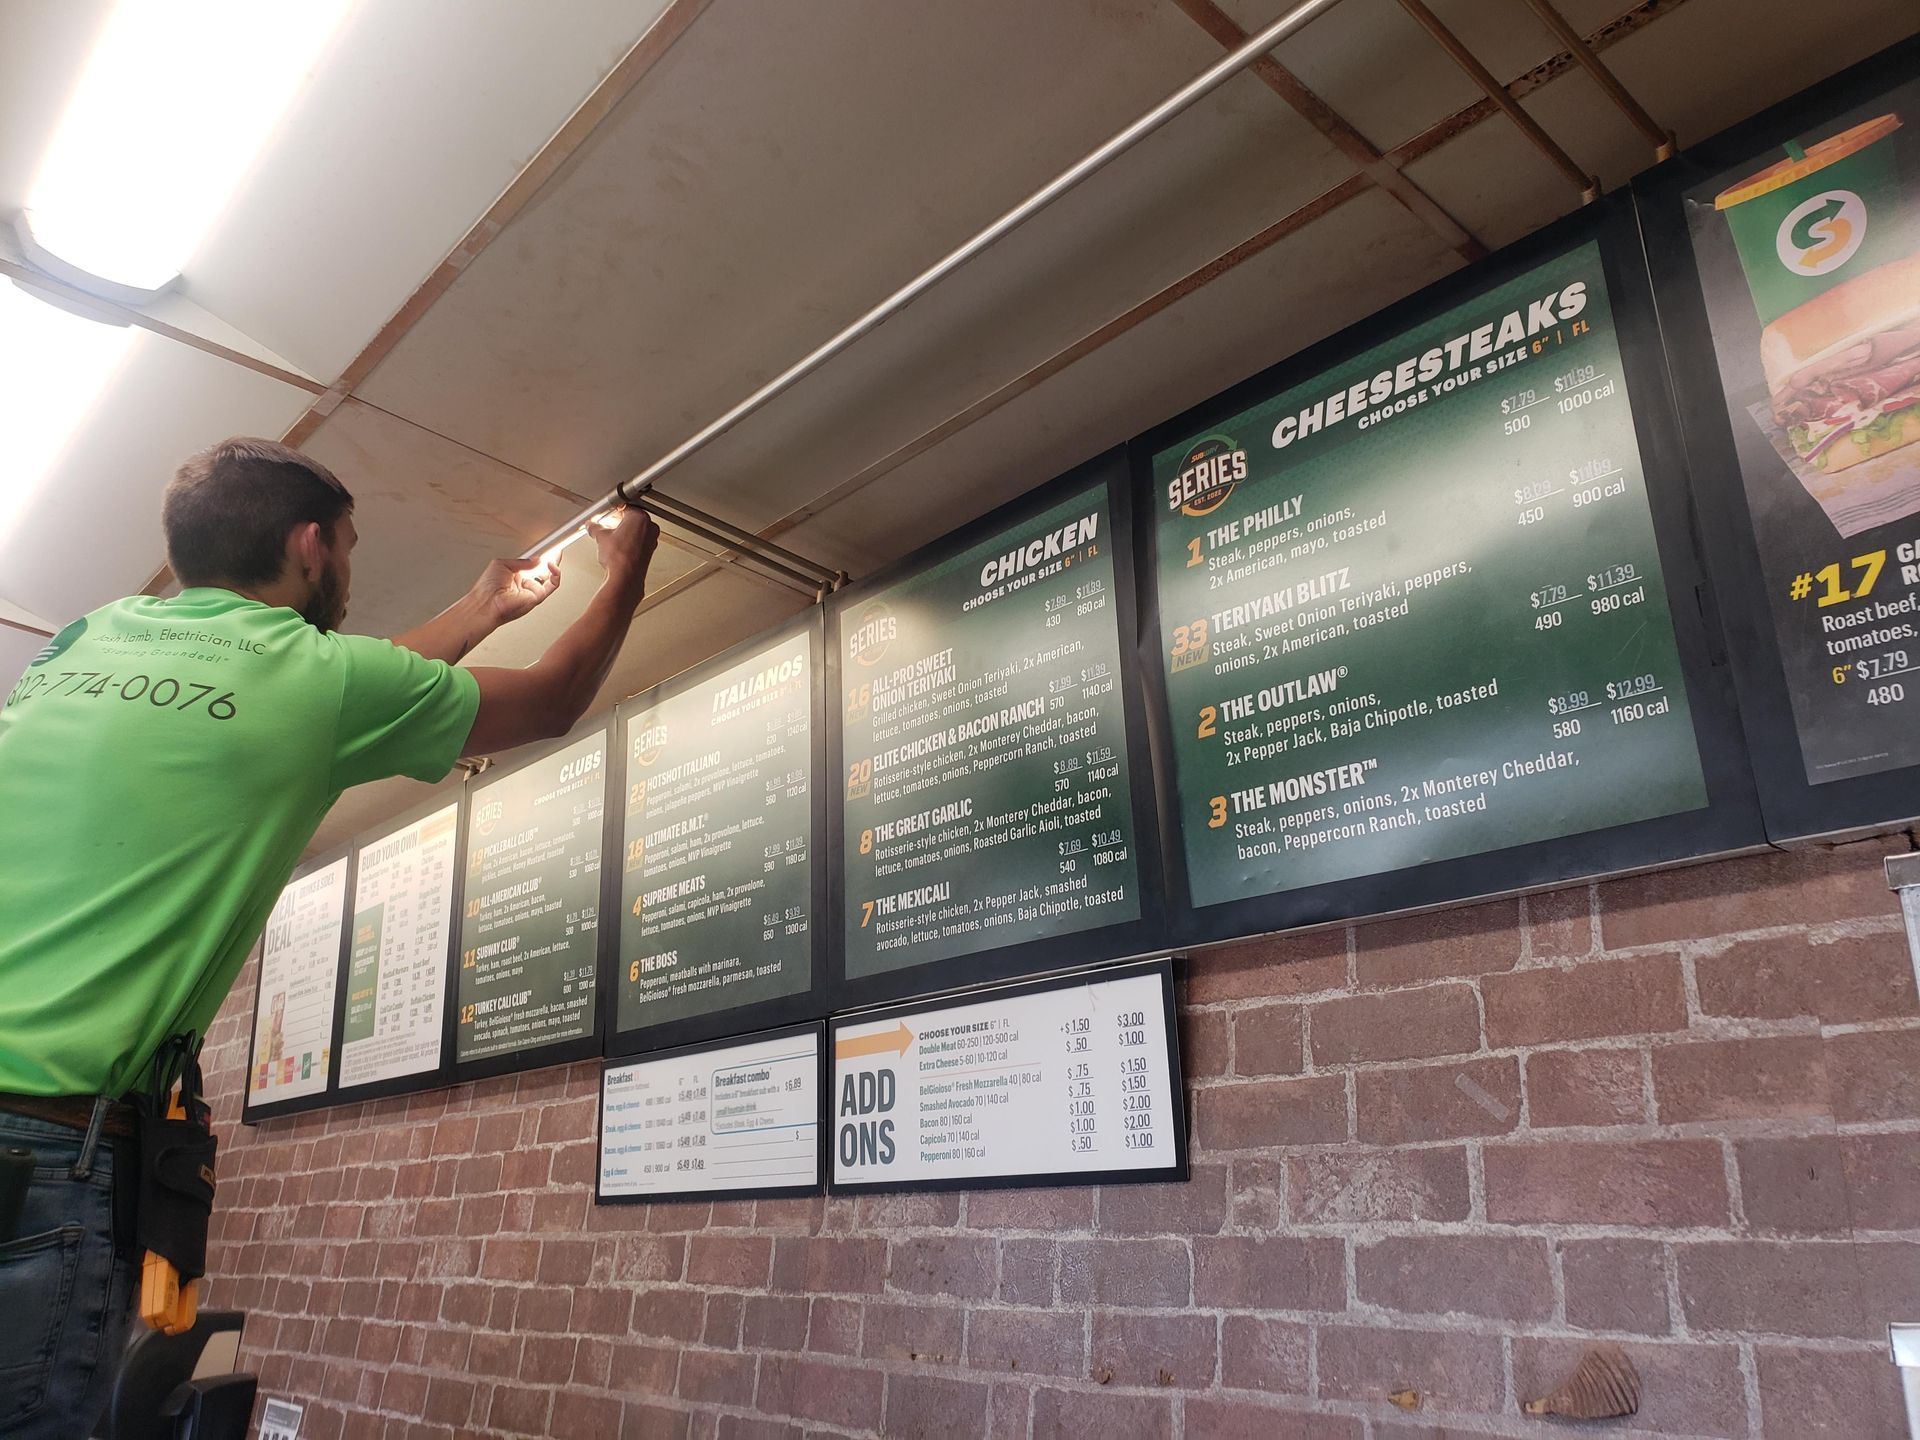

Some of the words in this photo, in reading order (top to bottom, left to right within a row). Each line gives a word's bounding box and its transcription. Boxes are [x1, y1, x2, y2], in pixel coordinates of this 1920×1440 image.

[1271, 281, 1588, 449] CHEESESTEAKS
[1358, 389, 1428, 429] CHOOSE
[1432, 367, 1482, 396] YOUR
[1486, 347, 1527, 374] SIZE
[1572, 321, 1590, 336] FL
[1505, 415, 1531, 435] 500
[1557, 390, 1592, 414] 1000
[1595, 380, 1615, 399] cal
[1169, 451, 1246, 510] SERIES
[980, 512, 1098, 587] CHICKEN
[1186, 536, 1204, 568] 1
[1207, 521, 1240, 550] THE
[1244, 494, 1304, 536] PHILLY
[1208, 548, 1246, 571] Steak,
[1249, 526, 1302, 557] peppers,
[1307, 507, 1356, 533] onions,
[1210, 573, 1223, 589] 2x
[1227, 551, 1287, 585] American,
[1291, 537, 1329, 562] mayo,
[1333, 511, 1386, 543] toasted
[962, 588, 1004, 612] CHOOSE
[1007, 574, 1036, 592] YOUR
[1038, 562, 1062, 579] SIZE
[1088, 545, 1098, 557] FL
[1531, 585, 1567, 609] $7.79
[1587, 564, 1635, 592] $11.39
[1790, 550, 1886, 608] #17
[1171, 619, 1207, 656] 33
[1212, 589, 1294, 633] TERIYAKI
[1298, 567, 1351, 604] BLITZ
[1213, 636, 1252, 656] Steak,
[1255, 619, 1294, 642] Sweet
[1298, 603, 1336, 627] Onion
[1340, 582, 1401, 614] Teriyaki,
[1405, 561, 1473, 594] peppers,
[1535, 611, 1562, 630] 490
[1591, 595, 1620, 615] 980
[1623, 586, 1645, 606] cal
[1822, 610, 1873, 632] Roast
[160, 628, 231, 648] Electrician
[238, 639, 266, 655] LLC
[1214, 654, 1260, 675] onions,
[1263, 646, 1279, 660] 2x
[1282, 626, 1350, 655] American,
[1353, 600, 1409, 631] toasted
[1826, 624, 1918, 656] tomatoes,
[872, 665, 914, 694] ALL-PRO
[916, 648, 953, 678] SWEET
[1177, 652, 1203, 668] NEW
[1856, 650, 1908, 680] $7.79
[712, 655, 803, 713] ITALIANOS
[872, 687, 906, 712] ONION
[908, 666, 956, 700] TERIYAKI
[1548, 691, 1589, 715] $8.99
[1607, 674, 1656, 700] $12.99
[1867, 684, 1904, 706] 480
[1198, 706, 1217, 738] 2
[1220, 694, 1255, 722] THE
[1226, 751, 1242, 767] 2x
[1244, 740, 1288, 764] Pepper
[1293, 729, 1327, 749] Jack,
[1331, 720, 1361, 739] Baja
[1365, 701, 1433, 730] Chipotle,
[1436, 678, 1498, 711] toasted
[1553, 719, 1581, 738] 580
[1611, 703, 1644, 725] 1160
[1647, 696, 1669, 716] cal
[633, 725, 667, 759] SERIES
[848, 759, 870, 787] 20
[874, 749, 899, 772] ELITE
[900, 732, 947, 762] CHICKEN
[948, 726, 958, 746] &
[958, 712, 999, 740] BACON
[1000, 697, 1045, 726] RANCH
[560, 750, 601, 784] CLUBS
[1055, 778, 1069, 792] 570
[1088, 768, 1105, 782] 1140
[1107, 763, 1118, 777] cal
[1208, 796, 1226, 829] 3
[1231, 790, 1266, 814] THE
[1236, 820, 1276, 839] Steak,
[1279, 806, 1340, 832] peppers,
[1343, 793, 1397, 815] onions,
[1401, 786, 1419, 802] 2x
[1423, 768, 1498, 799] Monterey
[1502, 749, 1581, 780] Cheddar,
[860, 830, 872, 854] 8
[875, 826, 894, 843] THE
[896, 812, 930, 837] GREAT
[932, 798, 972, 824] GARLIC
[1059, 839, 1080, 855] $7.69
[1092, 829, 1120, 847] $10.49
[1237, 839, 1281, 860] bacon,
[1284, 815, 1366, 850] Peppercorn
[1370, 811, 1422, 834] Ranch,
[1425, 793, 1487, 820] toasted
[362, 850, 380, 872] BUILD
[382, 839, 400, 864] YOUR
[400, 830, 418, 854] OWN
[1060, 860, 1075, 873] 540
[1093, 851, 1113, 866] 1080
[1115, 847, 1127, 861] cal
[633, 896, 641, 916] 4
[643, 884, 677, 908] SUPREME
[679, 875, 705, 895] MEATS
[860, 901, 874, 928] 7
[876, 896, 896, 916] THE
[898, 882, 950, 911] MEXICALI
[876, 910, 936, 934] Rotisserie-style
[938, 901, 972, 920] chicken,
[973, 900, 984, 911] 2x
[986, 891, 1016, 910] Pepper
[1019, 887, 1042, 902] Jack,
[1045, 874, 1087, 896] smashed
[268, 921, 292, 955] DEAL
[464, 949, 475, 968] 11
[477, 942, 500, 960] SUBWAY
[629, 961, 639, 982] 6
[641, 957, 655, 973] THE
[656, 951, 677, 969] BOSS
[461, 1004, 474, 1024] 12
[475, 1000, 497, 1015] TURKEY
[919, 1030, 949, 1040] CHOOSE
[950, 1026, 971, 1035] YOUR
[972, 1022, 988, 1032] SIZE
[1118, 1012, 1144, 1027] $3.00
[919, 1043, 940, 1054] Double
[941, 1041, 956, 1051] Meat
[919, 1061, 935, 1071] Extra
[936, 1057, 959, 1069] Cheese
[607, 1073, 633, 1086] Breakfast
[715, 1071, 746, 1087] Breakfast
[785, 1077, 801, 1092] $6.89
[840, 1068, 895, 1117] ADD
[840, 1120, 895, 1168] ONS
[920, 1118, 938, 1128] Bacon
[921, 1151, 951, 1162] Pepperoni
